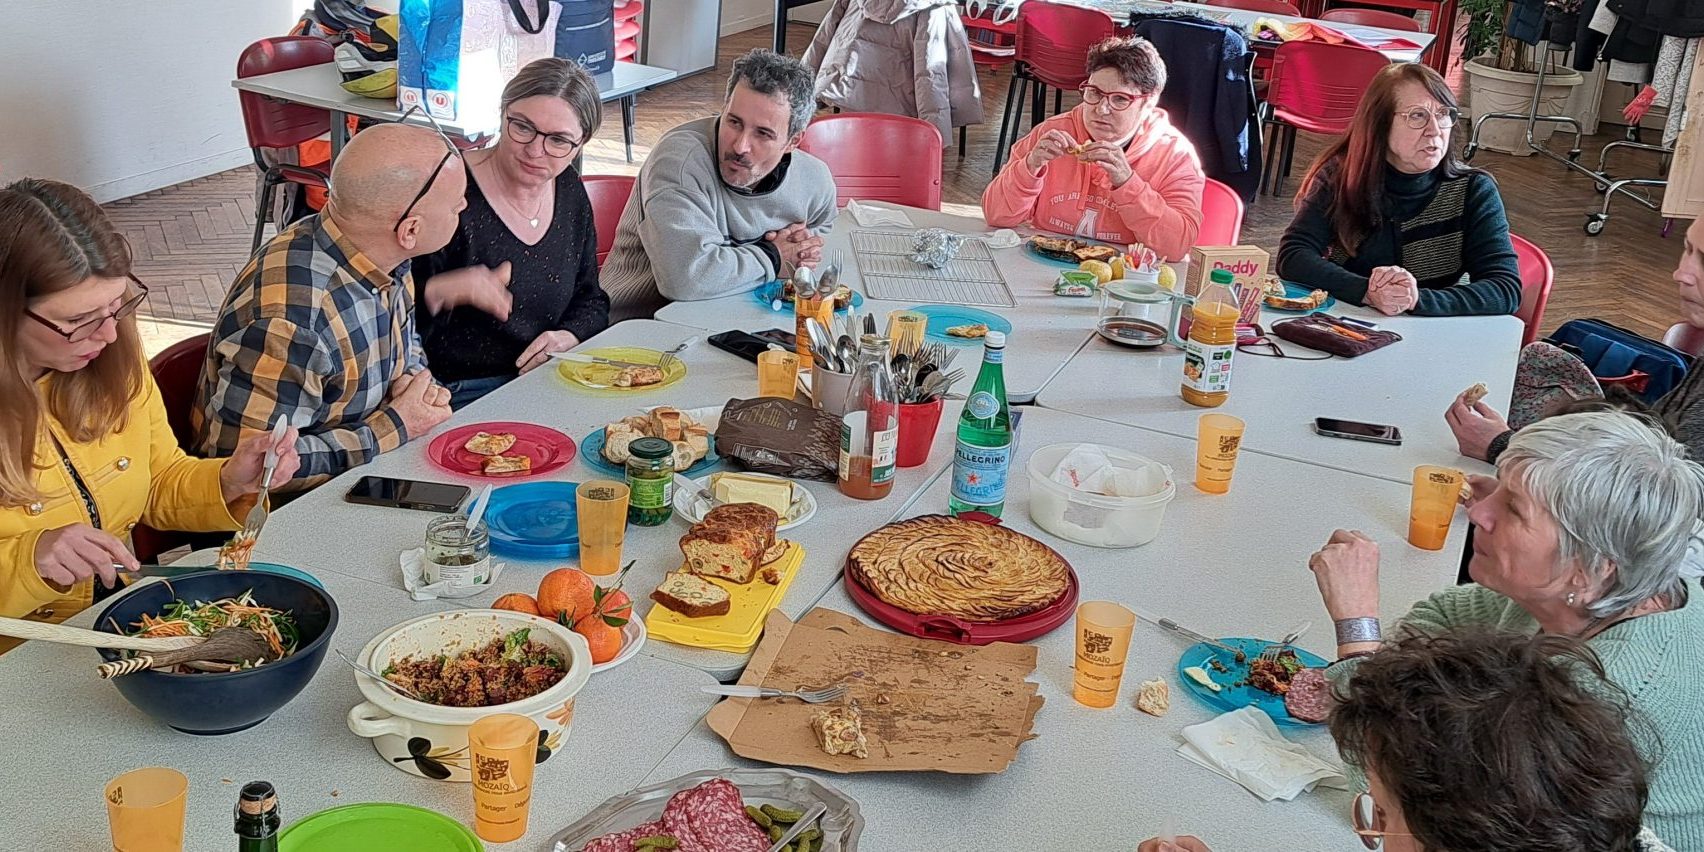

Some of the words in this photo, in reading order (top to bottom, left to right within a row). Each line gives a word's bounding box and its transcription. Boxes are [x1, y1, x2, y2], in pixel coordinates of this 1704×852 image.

[1050, 194, 1064, 205] YOU
[956, 448, 1005, 464] PELLEGRINO
[481, 802, 508, 812] Partager
